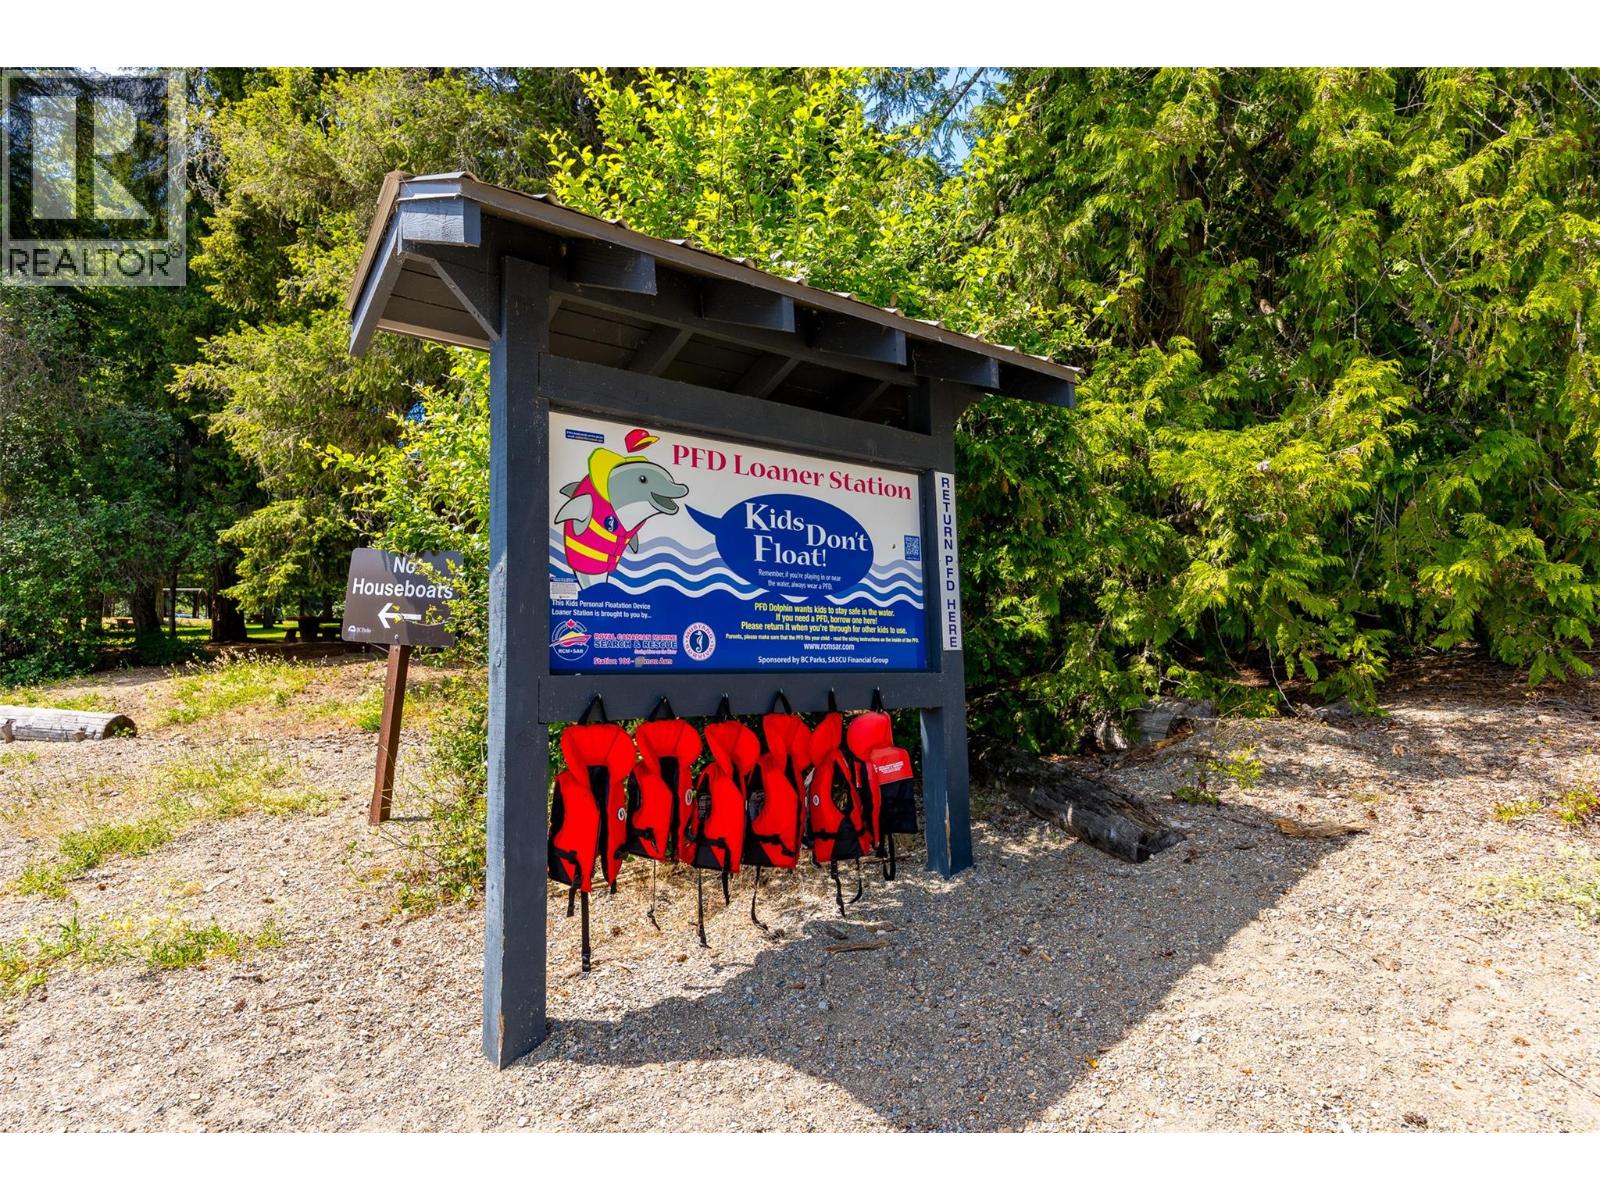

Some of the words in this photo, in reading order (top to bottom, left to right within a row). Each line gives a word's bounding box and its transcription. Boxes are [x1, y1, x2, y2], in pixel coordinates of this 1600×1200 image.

[672, 444, 727, 471] PFD
[733, 454, 824, 486] Loaner
[829, 470, 912, 500] Station
[941, 477, 953, 550] RETURN
[744, 502, 805, 532] Kids
[806, 524, 869, 552] Don't
[753, 535, 827, 567] Float!
[393, 556, 416, 574] No
[758, 568, 784, 578] Remember,
[804, 572, 820, 581] playing
[945, 555, 955, 591] PFD
[352, 577, 453, 599] Houseboats
[791, 581, 806, 589] always
[580, 600, 603, 608] Personal
[605, 601, 632, 609] Floatation
[633, 602, 650, 610] Device
[754, 602, 768, 611] PFD
[769, 603, 793, 613] Dolphin
[794, 605, 813, 613] wants
[814, 605, 827, 614] kids
[835, 607, 847, 616] stay
[868, 608, 877, 616] the
[878, 609, 895, 617] water.
[601, 610, 622, 619] brought
[782, 614, 793, 623] you
[816, 615, 829, 624] PFD,
[831, 616, 850, 624] borrow
[741, 621, 763, 630] Please
[764, 622, 784, 630] return
[791, 623, 808, 631] when
[809, 624, 828, 633] you're
[829, 624, 851, 634] through
[852, 625, 861, 633] for
[862, 626, 876, 634] other
[877, 626, 889, 634] kids
[947, 599, 957, 648] HERE
[594, 640, 631, 649] SEARCH
[633, 640, 640, 649] &
[643, 640, 677, 649] RESCUE
[758, 656, 791, 664] Sponsored
[792, 656, 800, 664] by
[809, 656, 827, 664] Parks,
